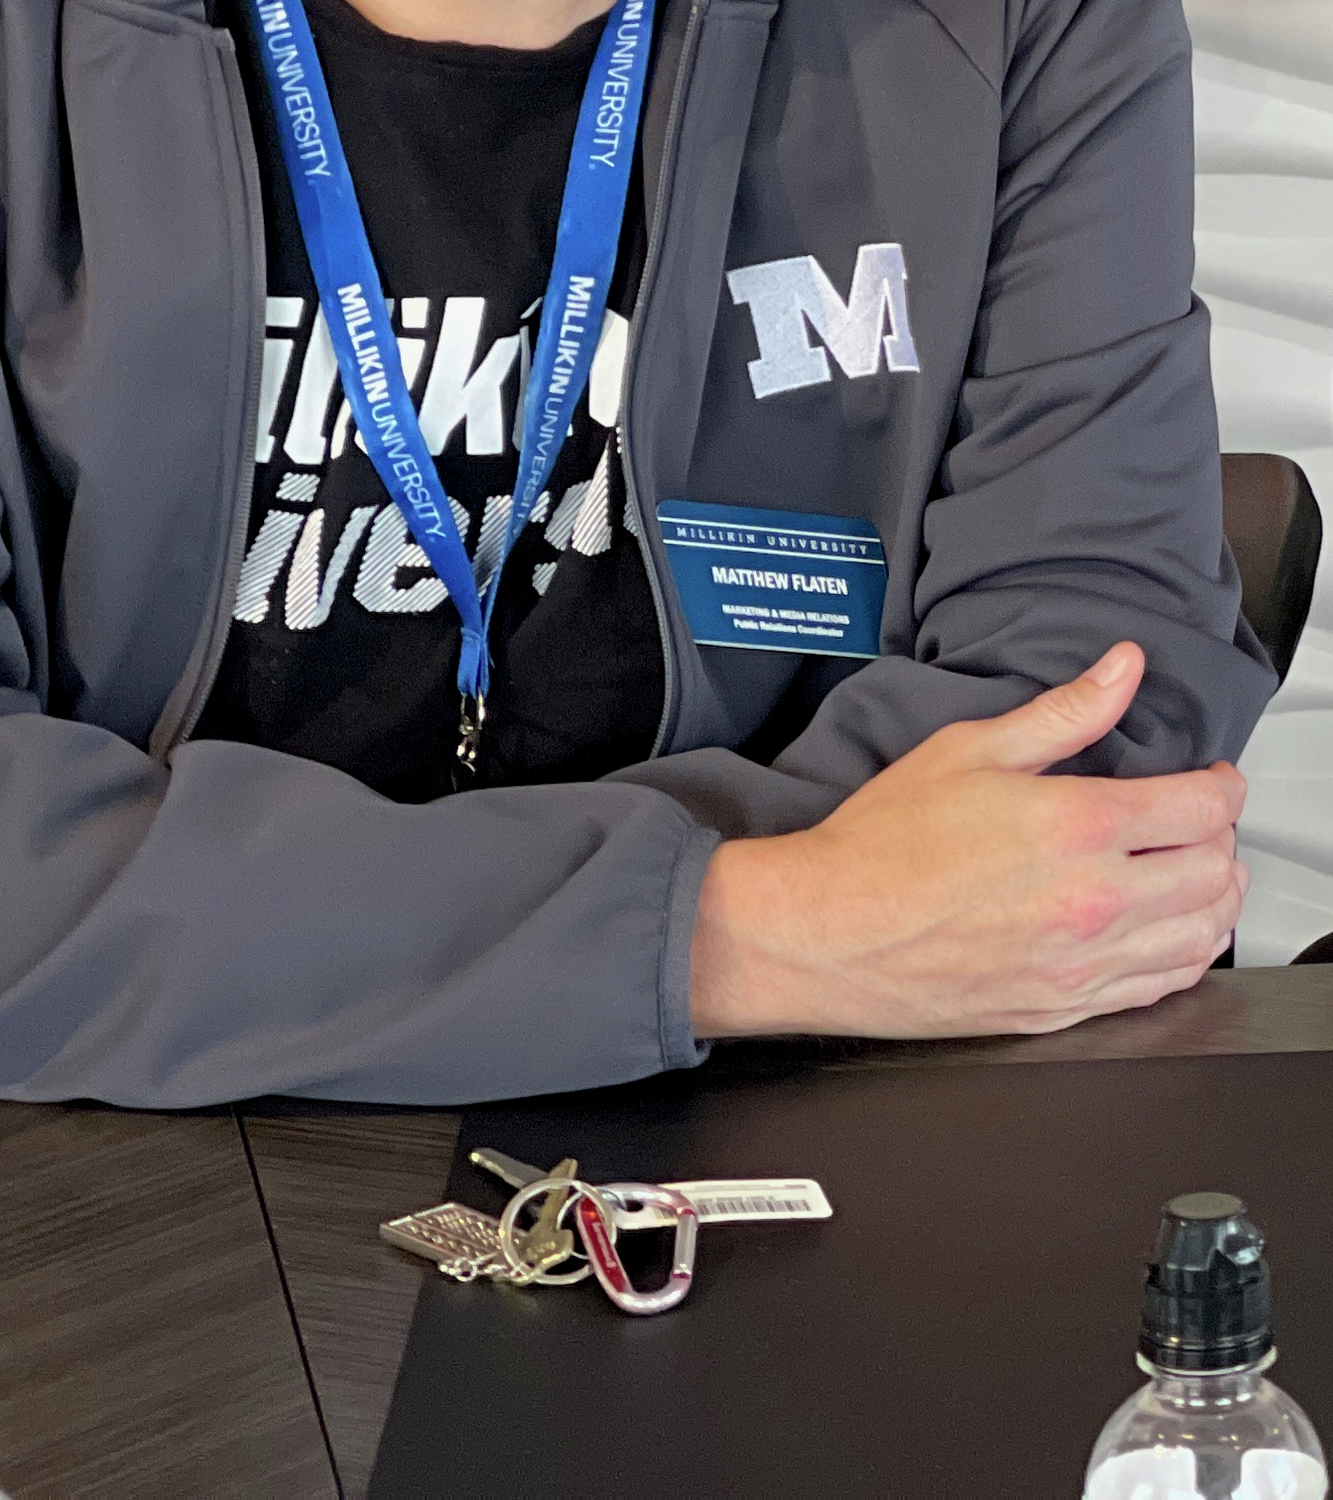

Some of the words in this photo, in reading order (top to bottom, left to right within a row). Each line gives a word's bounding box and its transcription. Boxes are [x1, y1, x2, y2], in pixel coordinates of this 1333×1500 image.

[336, 283, 390, 403] MILLIKIN
[548, 275, 596, 395] MILLIKIN
[725, 242, 920, 399] M
[676, 527, 756, 544] MILLIKIN
[767, 536, 867, 555] UNIVERSITY
[711, 566, 789, 590] MATTHEW
[792, 573, 848, 596] FLATEN
